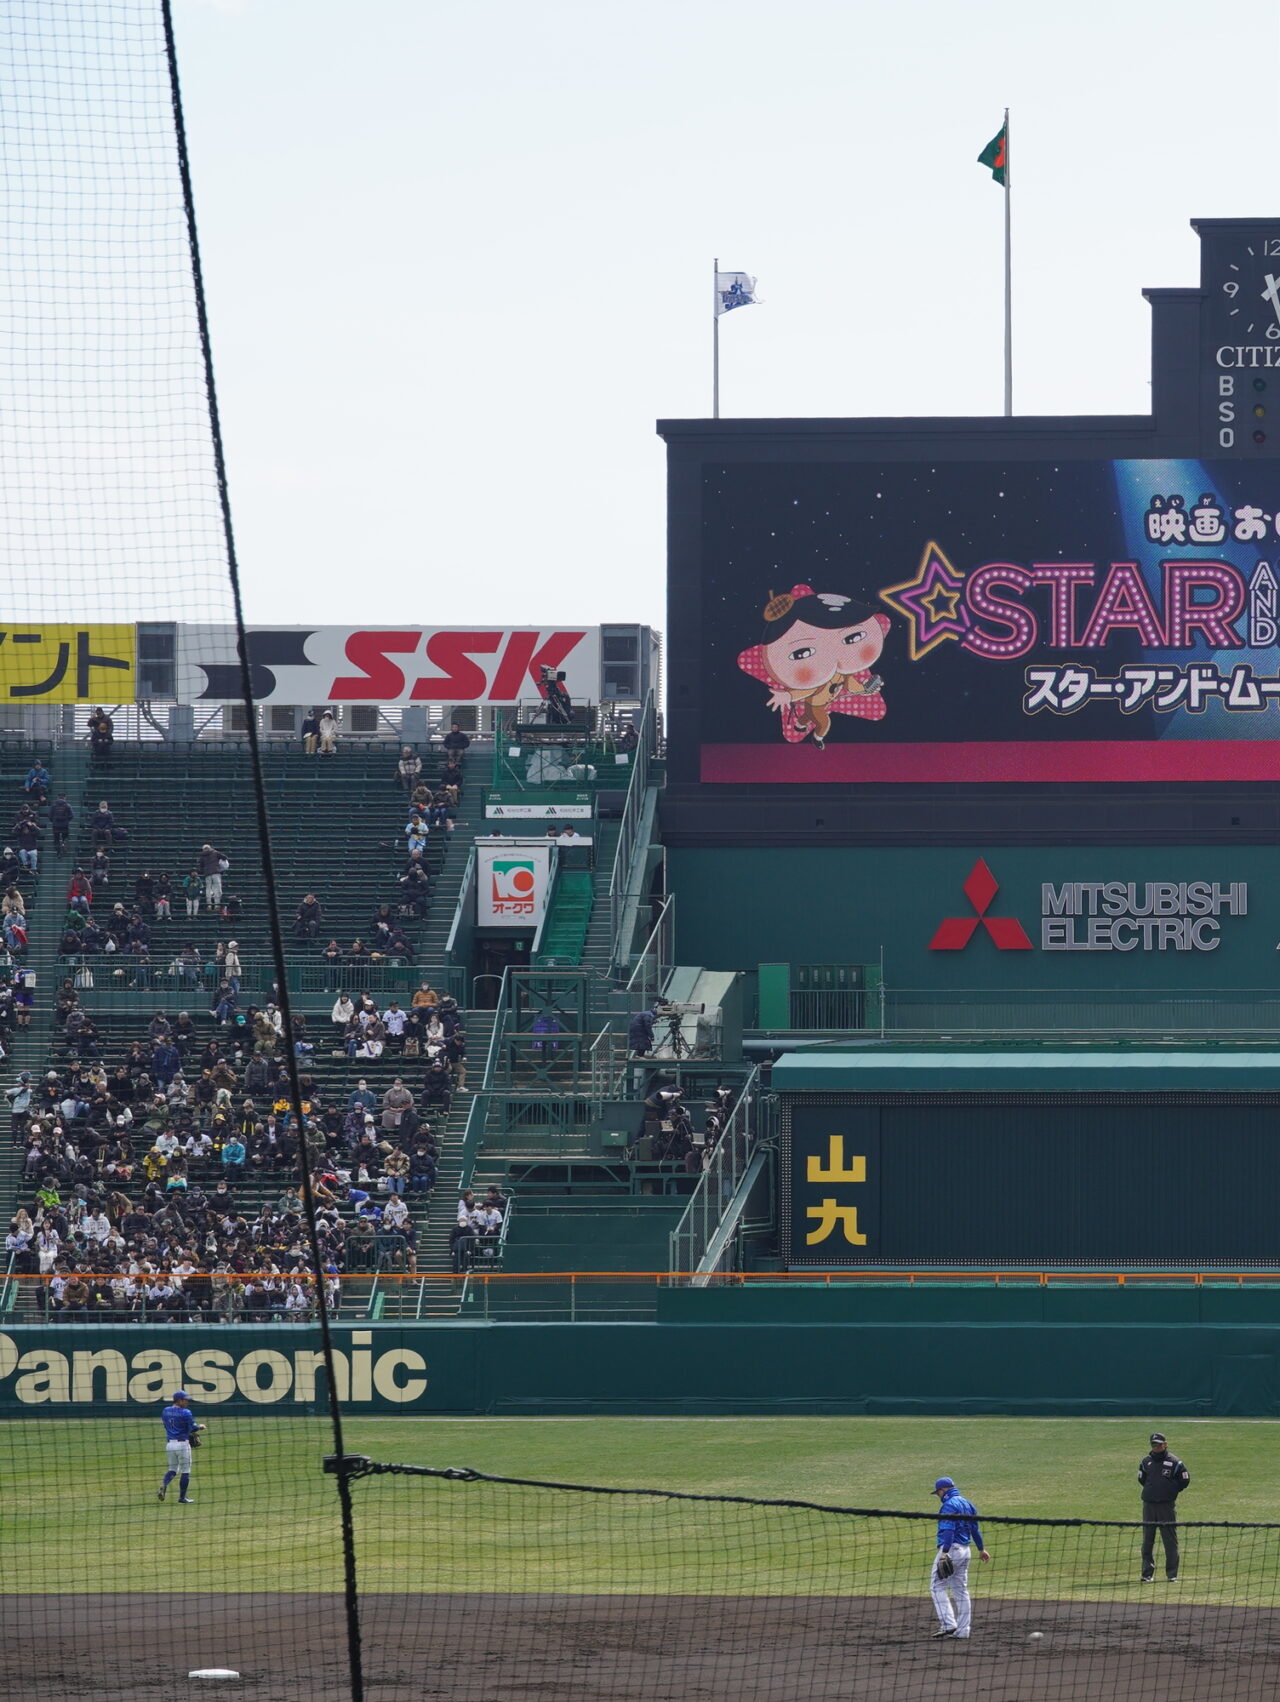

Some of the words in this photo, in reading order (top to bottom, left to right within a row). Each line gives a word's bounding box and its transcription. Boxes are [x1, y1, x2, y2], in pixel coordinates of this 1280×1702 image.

[1223, 282, 1240, 298] 9
[1219, 375, 1234, 396] B
[1218, 401, 1235, 422] S
[1219, 427, 1234, 448] O
[1149, 508, 1225, 542] 映画
[962, 560, 1245, 659] STAR
[1250, 561, 1278, 646] AND
[0, 632, 130, 698] ント
[328, 631, 588, 700] SSK
[492, 903, 534, 914] オークワ
[1041, 882, 1248, 916] MITSUBISHI
[1041, 917, 1221, 951] ELECTRIC
[806, 1135, 867, 1246] 山九
